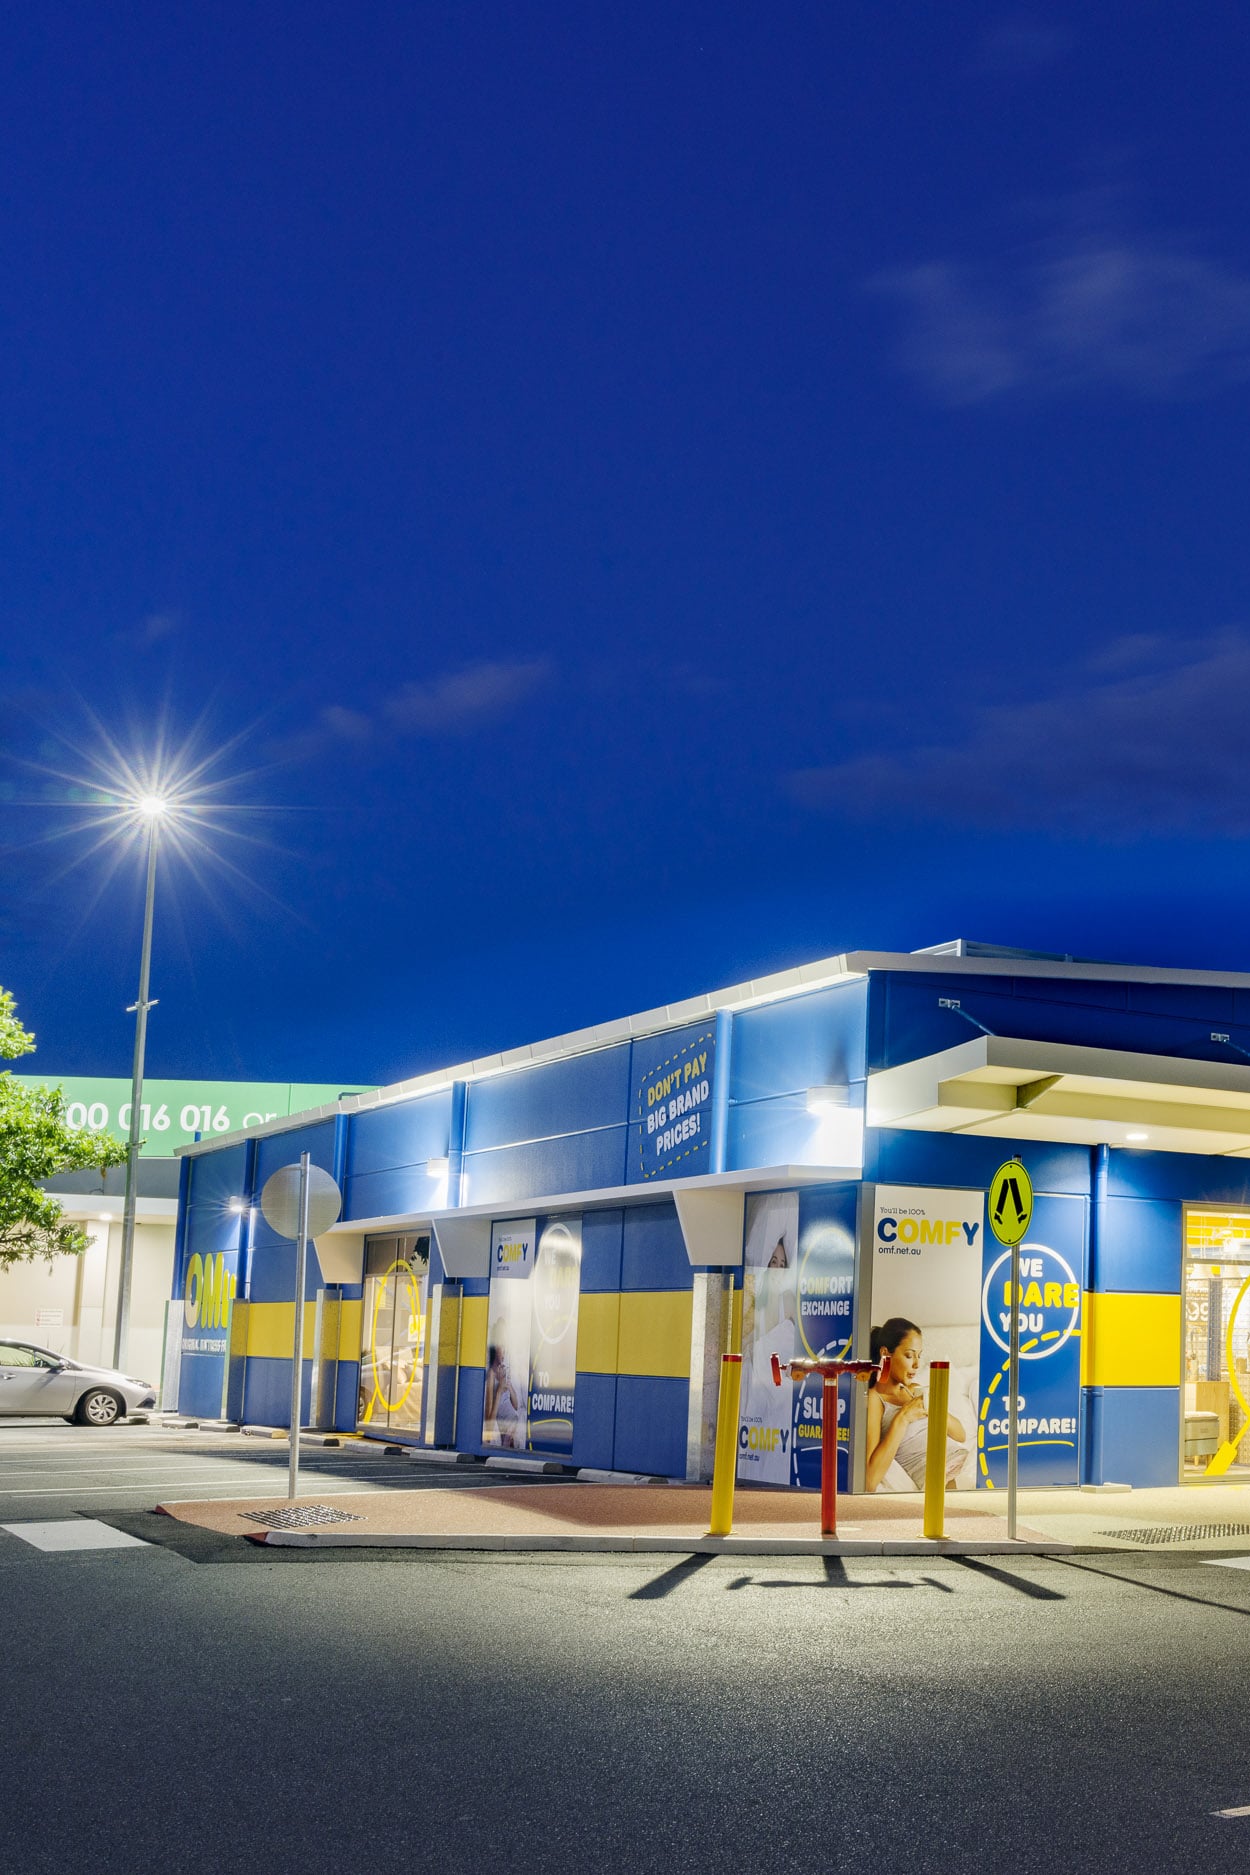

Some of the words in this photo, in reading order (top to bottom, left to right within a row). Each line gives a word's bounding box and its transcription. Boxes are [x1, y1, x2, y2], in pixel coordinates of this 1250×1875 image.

[648, 1068, 681, 1107] DON'T
[684, 1051, 707, 1083] PAY
[647, 1105, 666, 1134] BIG
[668, 1080, 709, 1120] BRAND
[180, 1105, 230, 1132] 016
[656, 1112, 700, 1156] PRICES!
[877, 1217, 980, 1246] COMFY
[497, 1243, 528, 1262] COMFY
[878, 1246, 921, 1256] omf.net.au
[800, 1276, 853, 1294] COMFORT
[1003, 1281, 1080, 1308] DARE
[801, 1301, 849, 1316] EXCHANGE
[999, 1312, 1044, 1333] YOU
[539, 1371, 549, 1388] TO
[532, 1393, 574, 1413] COMPARE!
[803, 1397, 846, 1421] SLP
[988, 1418, 1076, 1435] COMPARE!
[740, 1425, 789, 1453] COMFY
